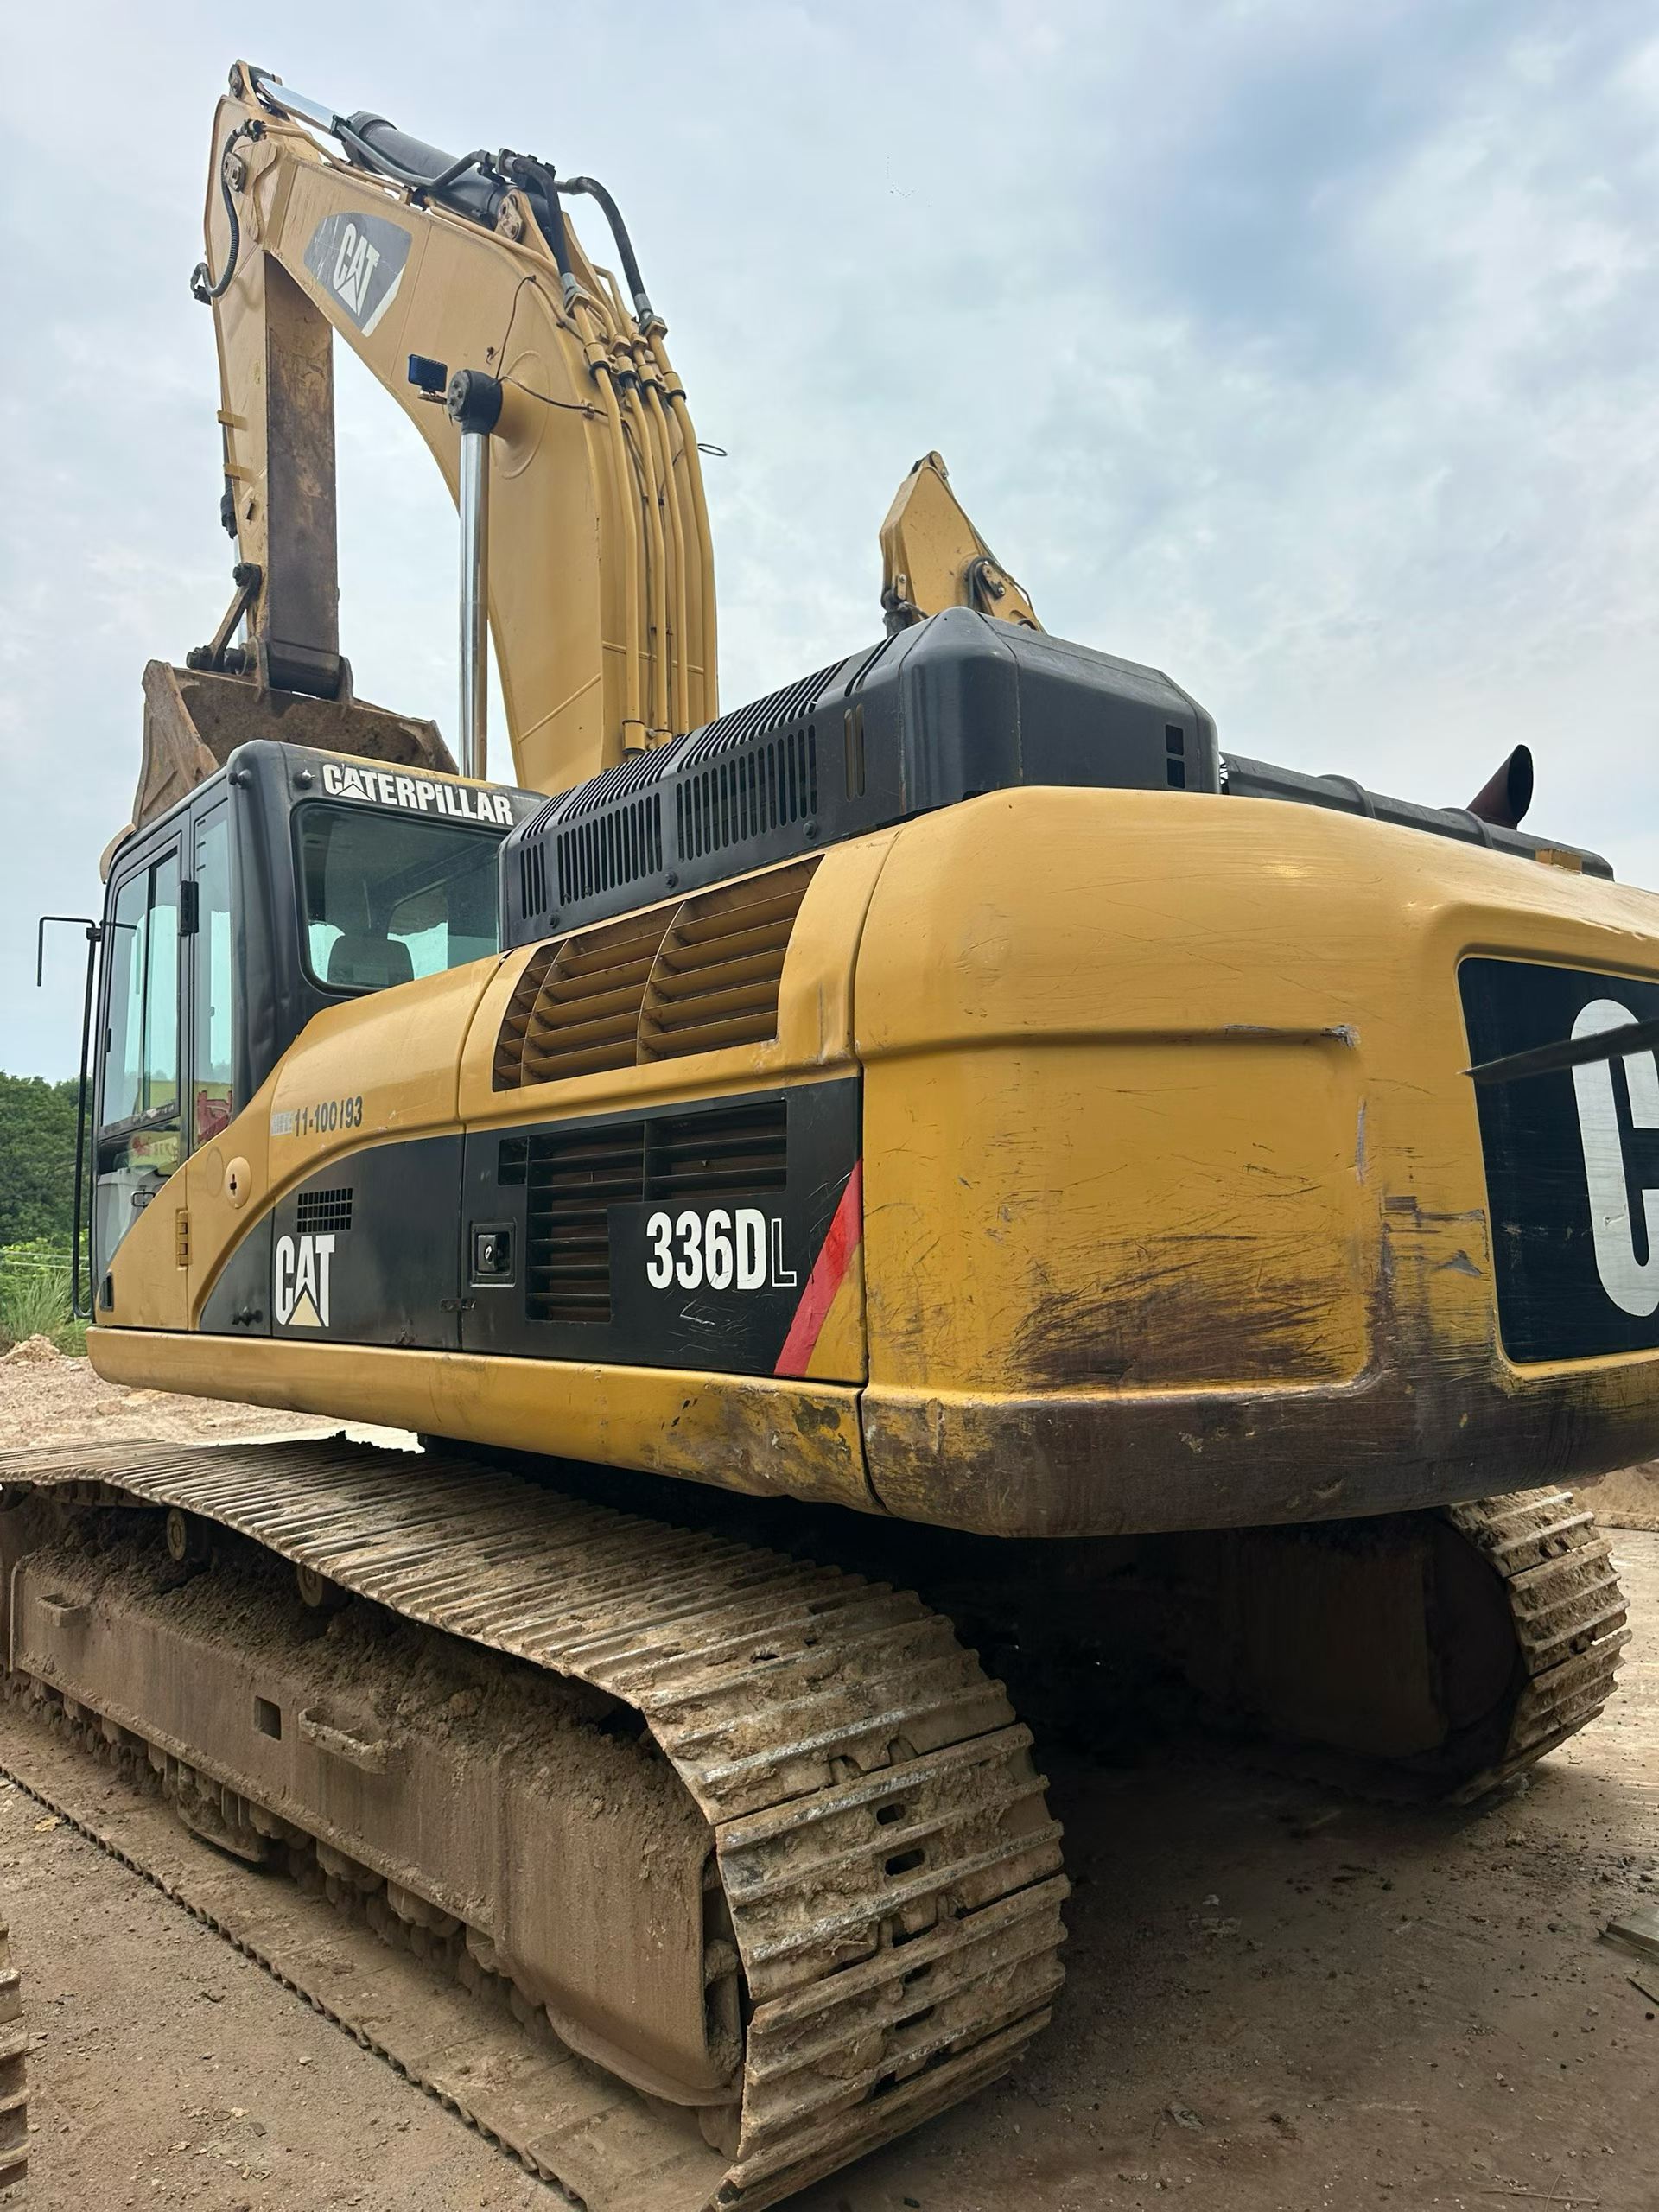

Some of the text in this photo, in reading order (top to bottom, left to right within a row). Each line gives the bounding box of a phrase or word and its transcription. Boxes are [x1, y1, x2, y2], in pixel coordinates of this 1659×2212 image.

[333, 223, 380, 316] CAT
[322, 764, 514, 826] CATERPILLAR
[275, 1234, 335, 1327] CAT
